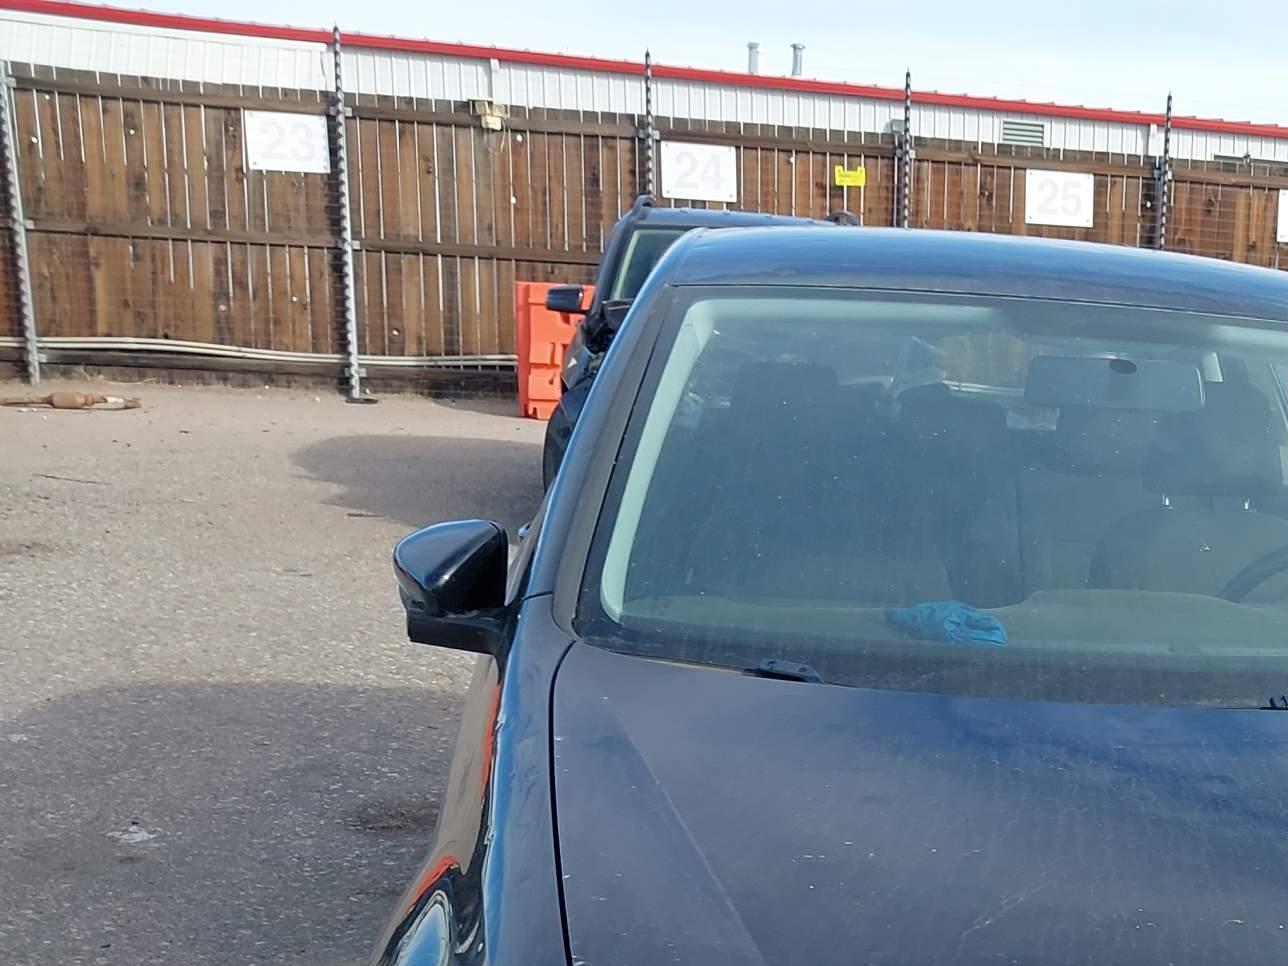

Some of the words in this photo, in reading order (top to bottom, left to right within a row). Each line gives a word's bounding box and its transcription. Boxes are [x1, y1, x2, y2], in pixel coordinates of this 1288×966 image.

[260, 120, 316, 162] 23
[674, 151, 724, 191] 24
[1037, 178, 1082, 217] 25
